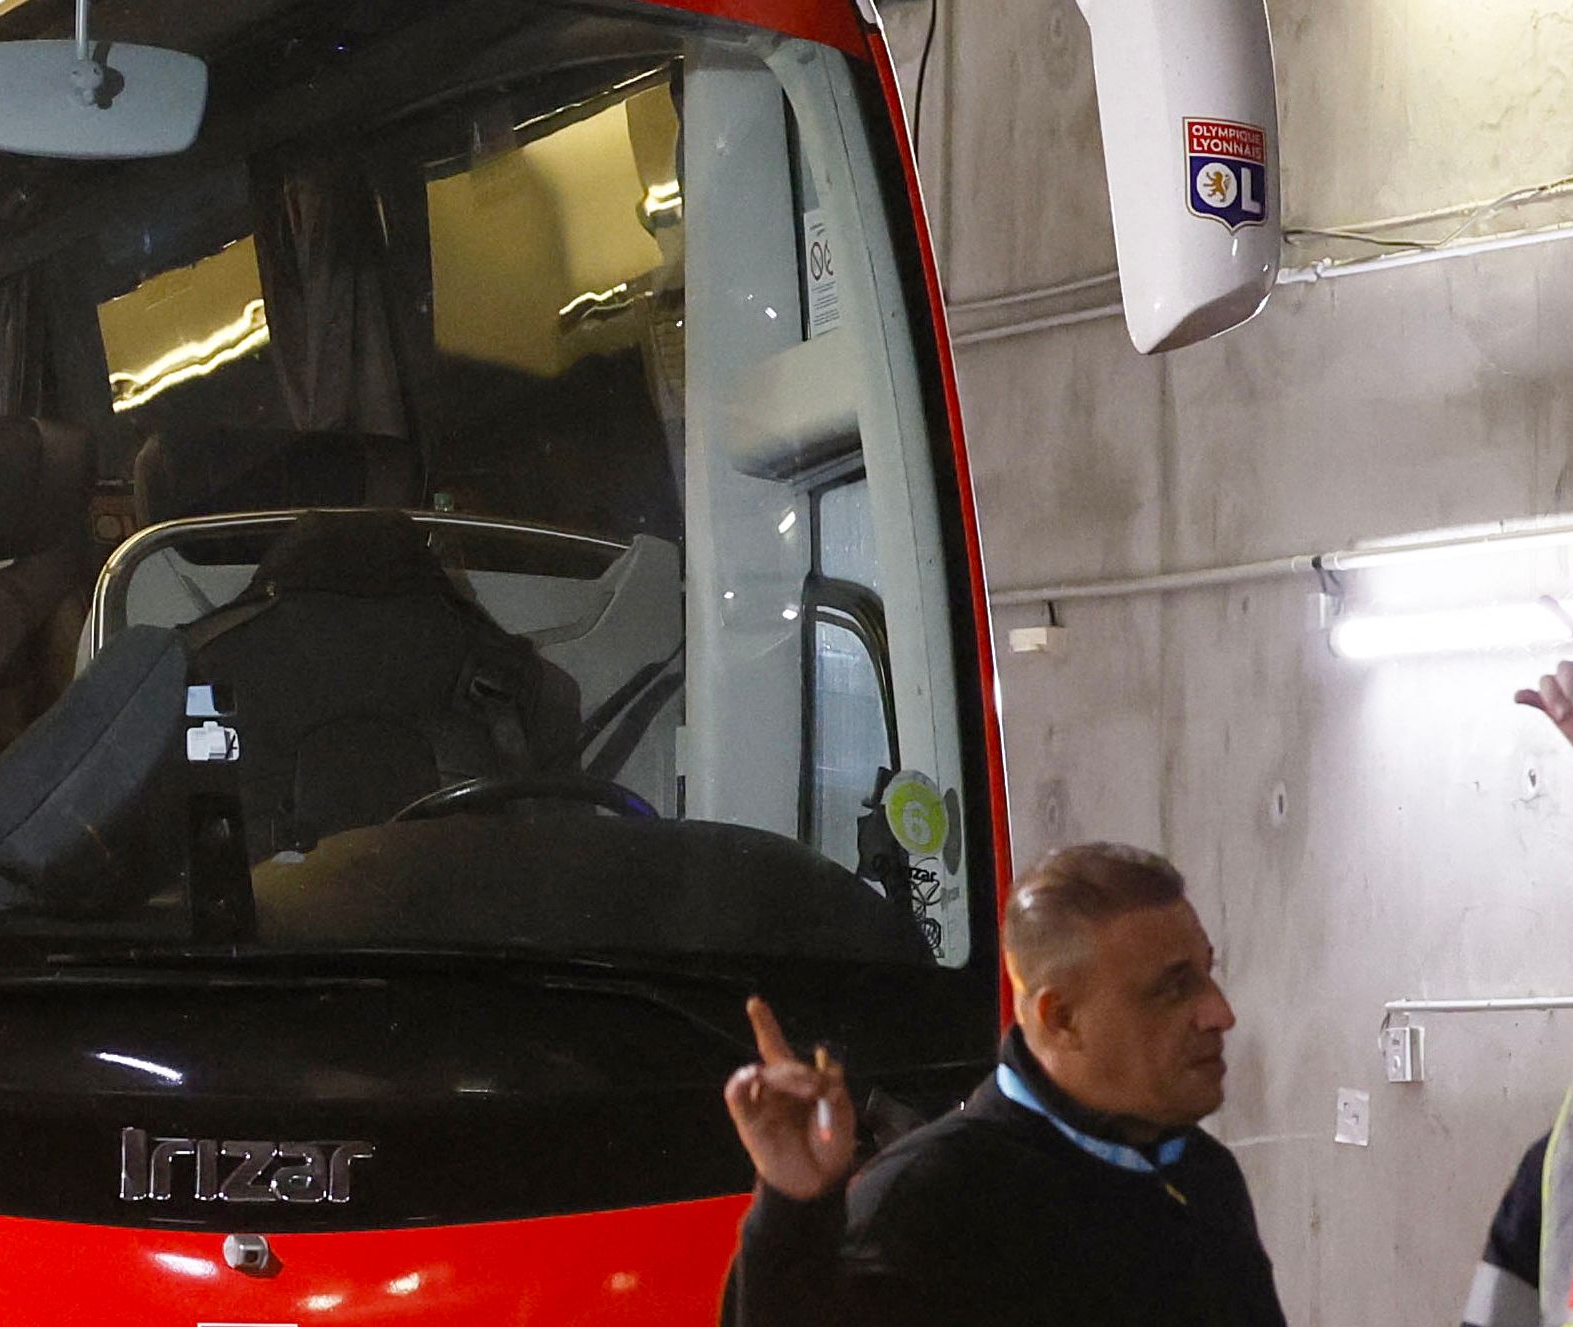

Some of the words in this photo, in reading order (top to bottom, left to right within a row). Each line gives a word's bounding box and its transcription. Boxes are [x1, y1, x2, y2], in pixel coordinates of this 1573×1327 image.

[1192, 125, 1261, 145] OLYMPIQUE
[1193, 138, 1262, 159] LYONNAIS
[1196, 162, 1261, 214] OL
[120, 1126, 376, 1202] Irizar
